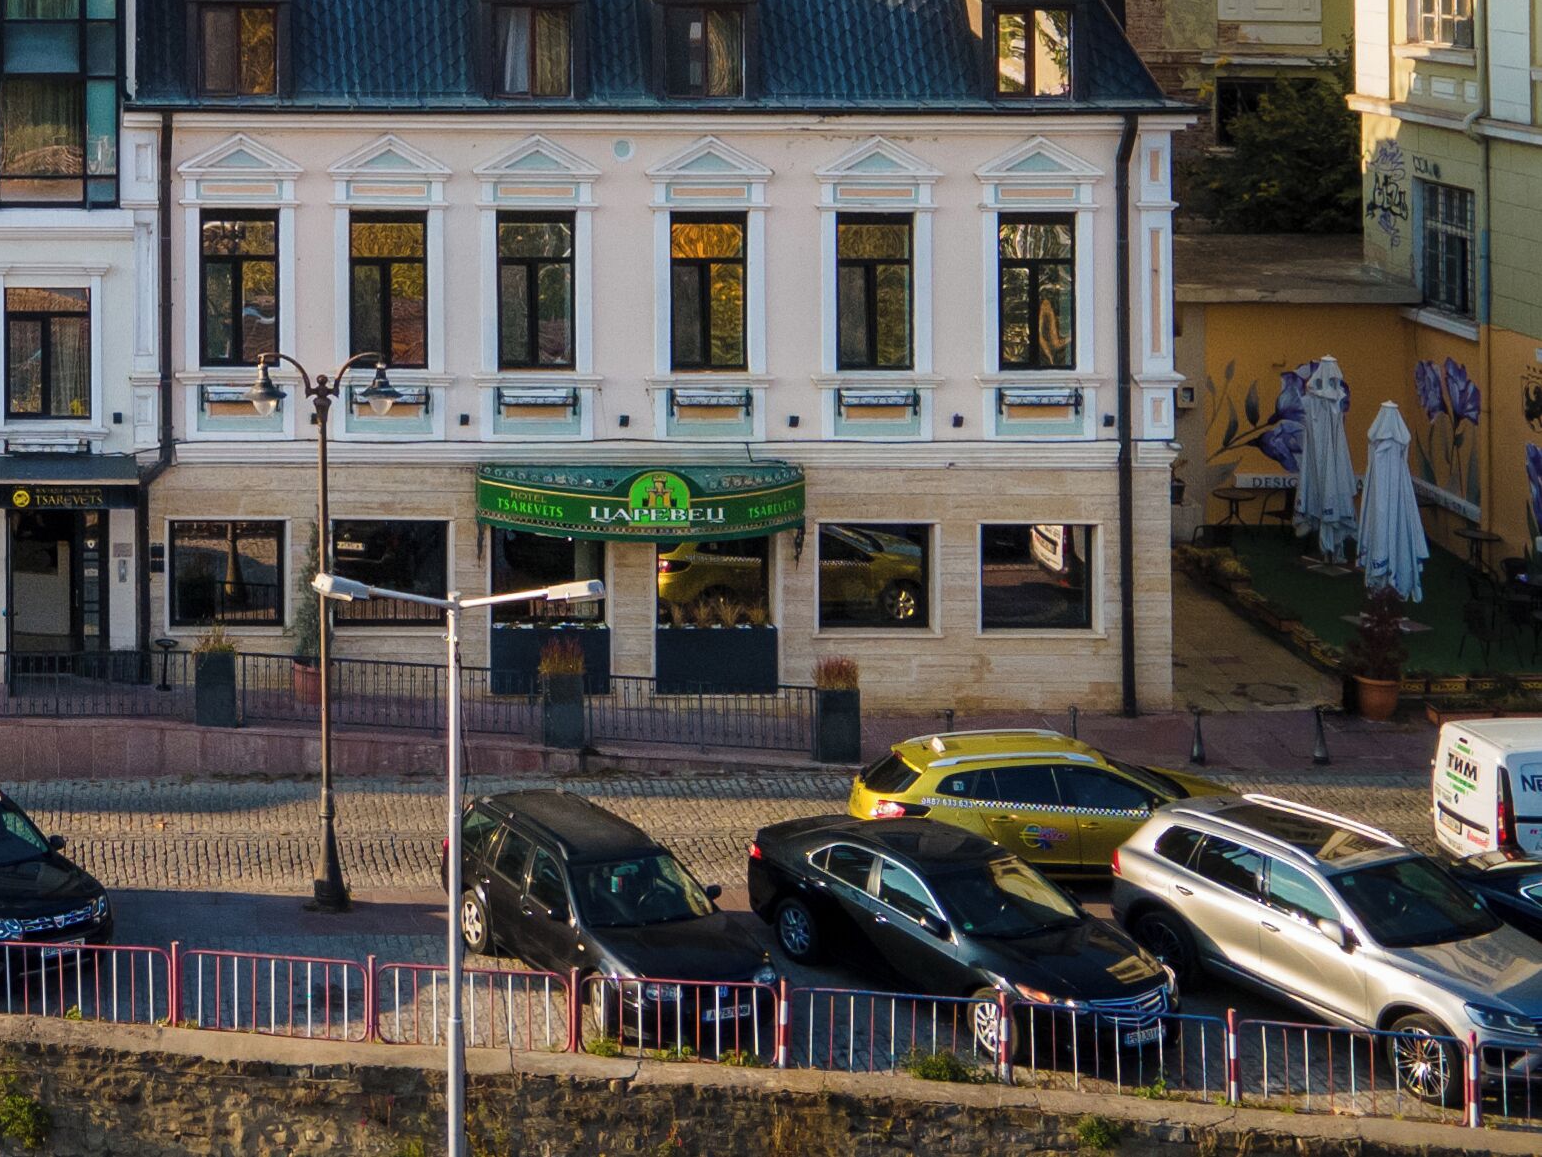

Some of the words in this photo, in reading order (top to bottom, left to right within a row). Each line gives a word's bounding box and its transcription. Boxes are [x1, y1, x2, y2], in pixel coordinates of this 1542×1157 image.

[497, 497, 565, 518] TSAREVETS
[589, 505, 726, 525] ЦАРЕВЕЦ
[747, 497, 798, 520] TSAREVETS
[1447, 751, 1478, 783] ТИМ
